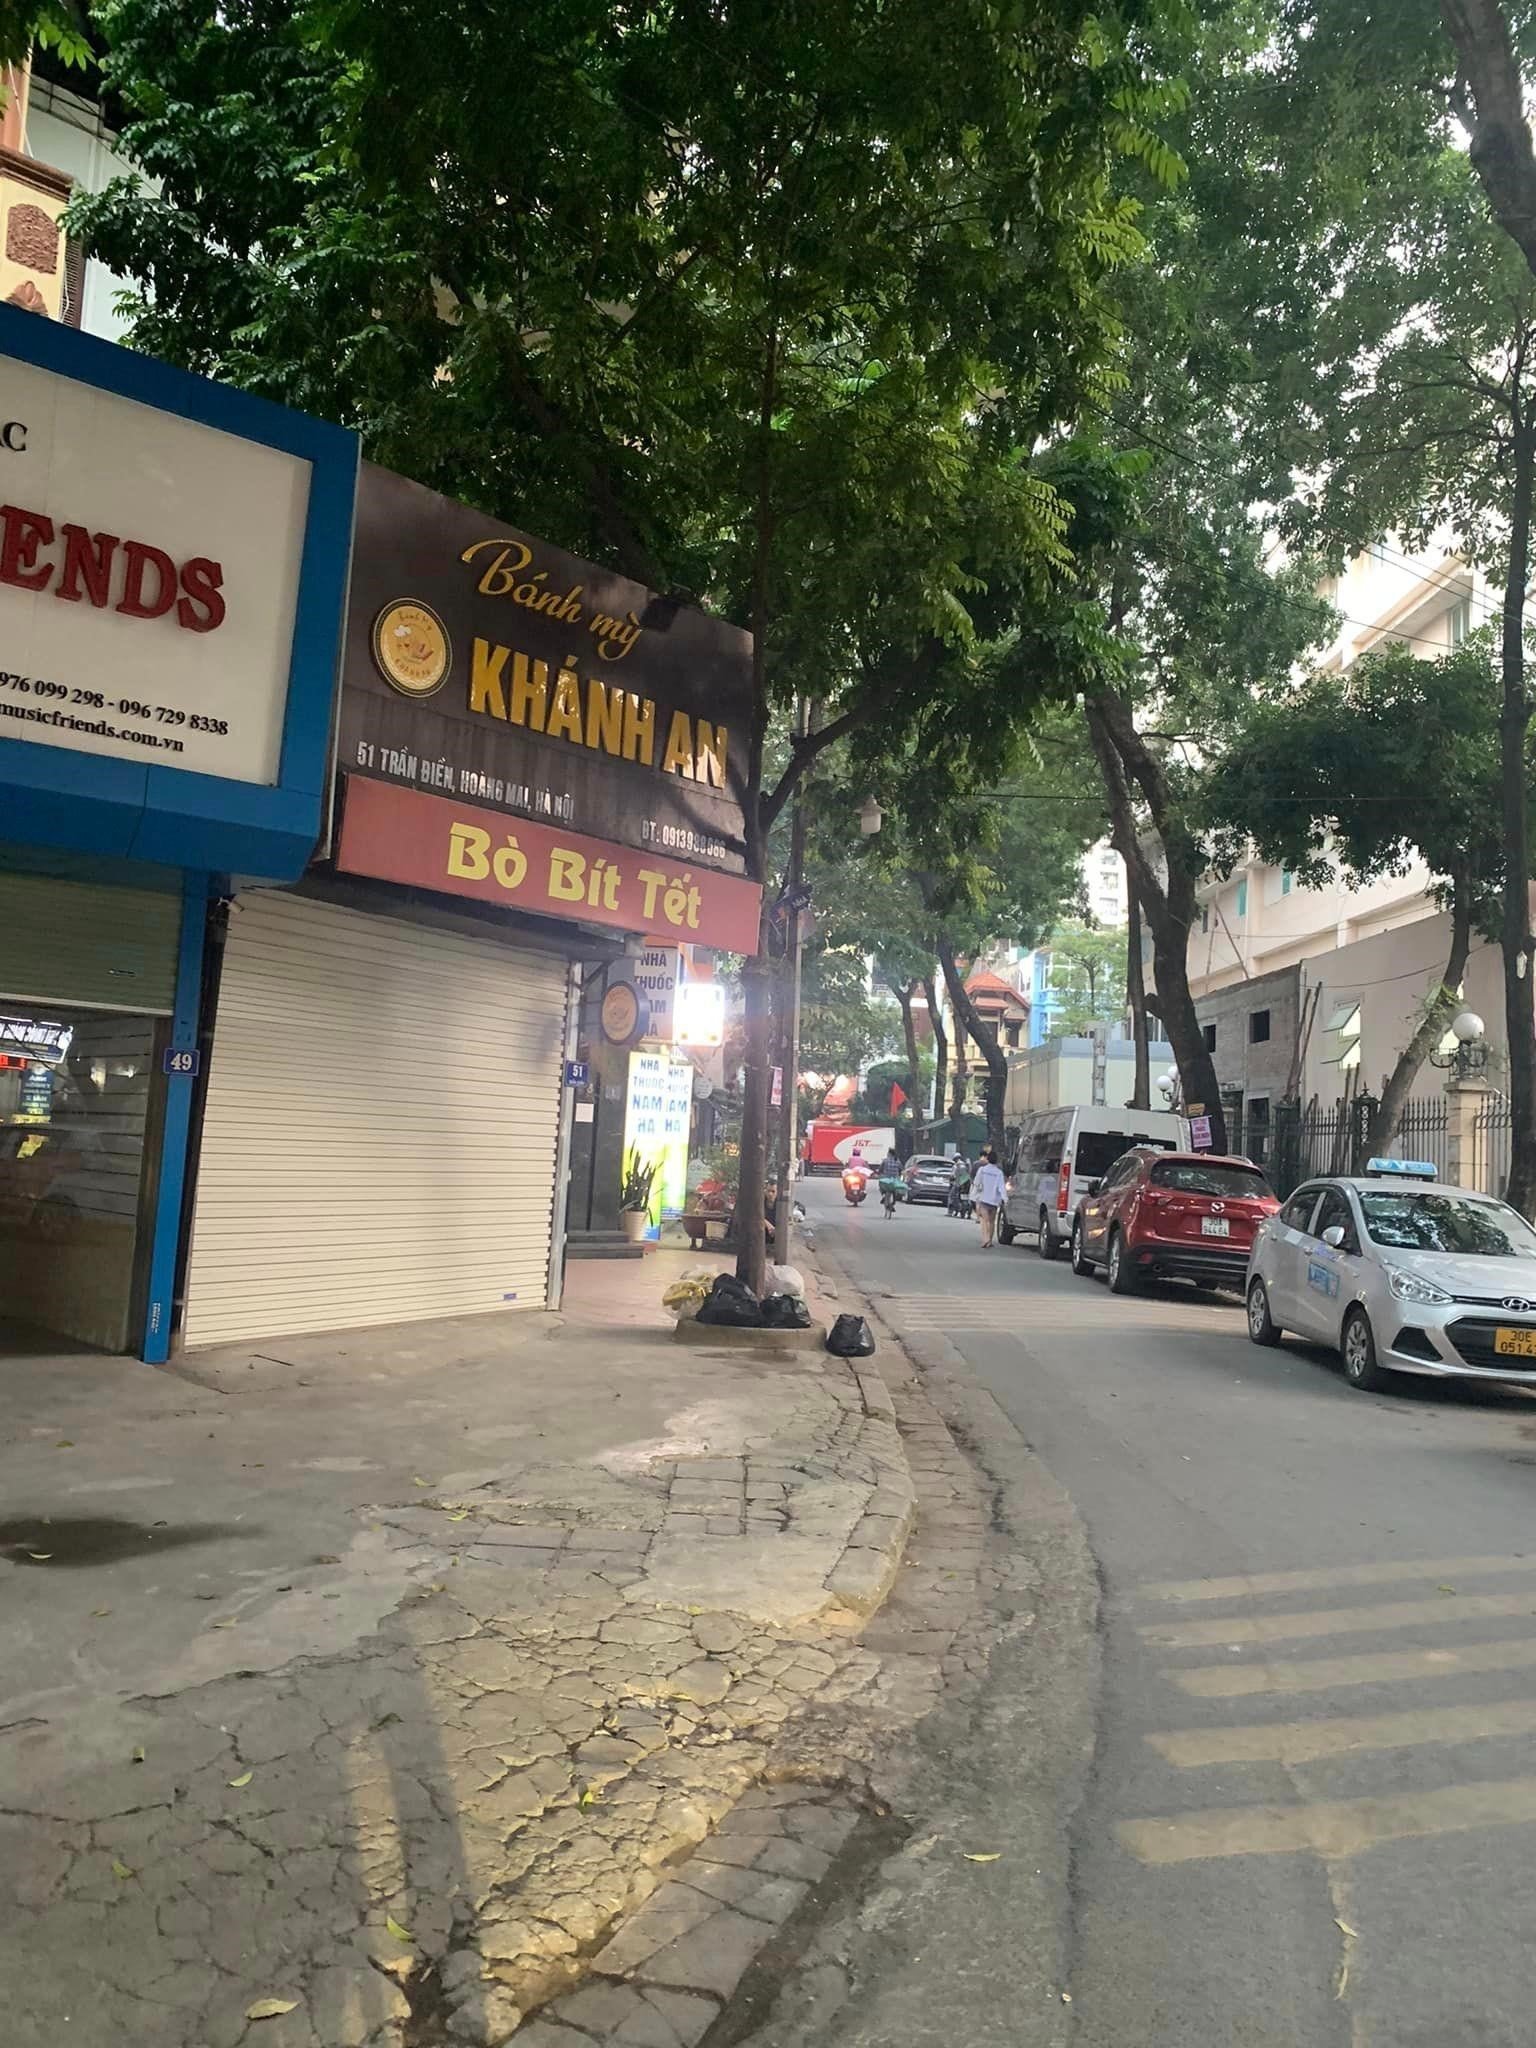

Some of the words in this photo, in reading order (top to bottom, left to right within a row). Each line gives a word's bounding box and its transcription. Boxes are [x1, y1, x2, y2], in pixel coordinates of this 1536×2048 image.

[0, 421, 28, 452] C
[0, 505, 226, 633] ENDS
[462, 539, 584, 624] Bánh
[589, 612, 642, 661] mỳ
[0, 671, 30, 692] 976
[34, 680, 68, 700] 099
[72, 688, 104, 709] 298
[119, 699, 151, 719] 096
[156, 707, 186, 725] 729
[190, 715, 229, 735] 8338
[470, 637, 655, 766] KHÁNH
[663, 711, 728, 789] AN
[0, 703, 184, 753] musicfriends.com.vn
[356, 741, 375, 767] 51
[380, 746, 418, 780] TRẦN
[421, 757, 455, 792] ĐIỀN,
[460, 770, 502, 803] HOÀNG
[506, 782, 532, 812] MAI,
[535, 789, 551, 815] HÀ
[554, 793, 575, 824] NỘI
[447, 822, 528, 889] Bò
[548, 847, 621, 911] Bít
[638, 869, 702, 929] Tết
[170, 1053, 192, 1072] 49
[572, 1064, 583, 1078] 51
[632, 1094, 663, 1112] NAM
[852, 1139, 871, 1147] J&T
[1500, 1341, 1536, 1354] 051.4
[1510, 1330, 1532, 1343] 30E
